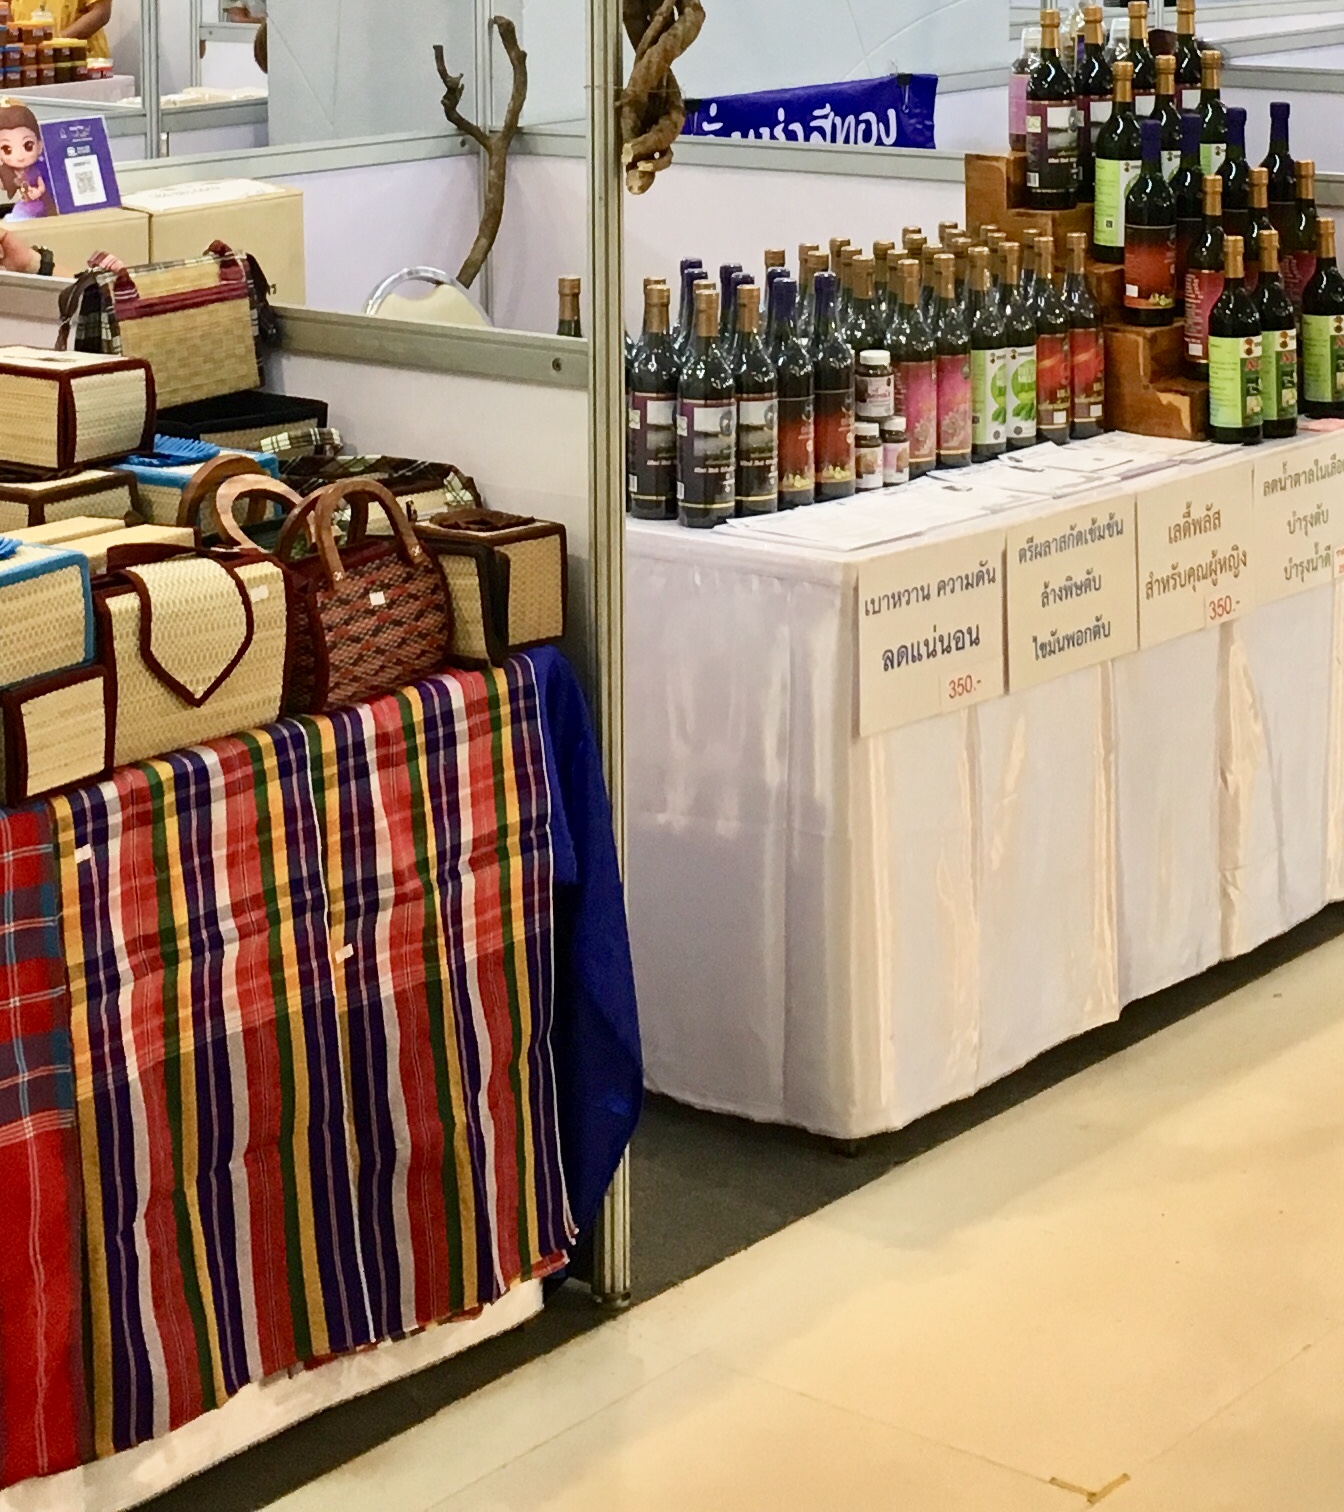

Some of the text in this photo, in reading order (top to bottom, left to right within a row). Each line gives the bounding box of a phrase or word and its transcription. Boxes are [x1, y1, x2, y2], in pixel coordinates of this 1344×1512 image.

[1286, 501, 1330, 537] บำรุงตับ
[864, 559, 997, 617] เบาหวาน ความดัน
[1040, 567, 1103, 609] ล้างพิษตับ
[1145, 543, 1248, 601] สำหรับคุณผู้หญิง
[881, 623, 981, 673] ลดแน่นอน
[1032, 613, 1112, 662] ไขมันพอกตับ
[948, 673, 982, 700] 350.-
